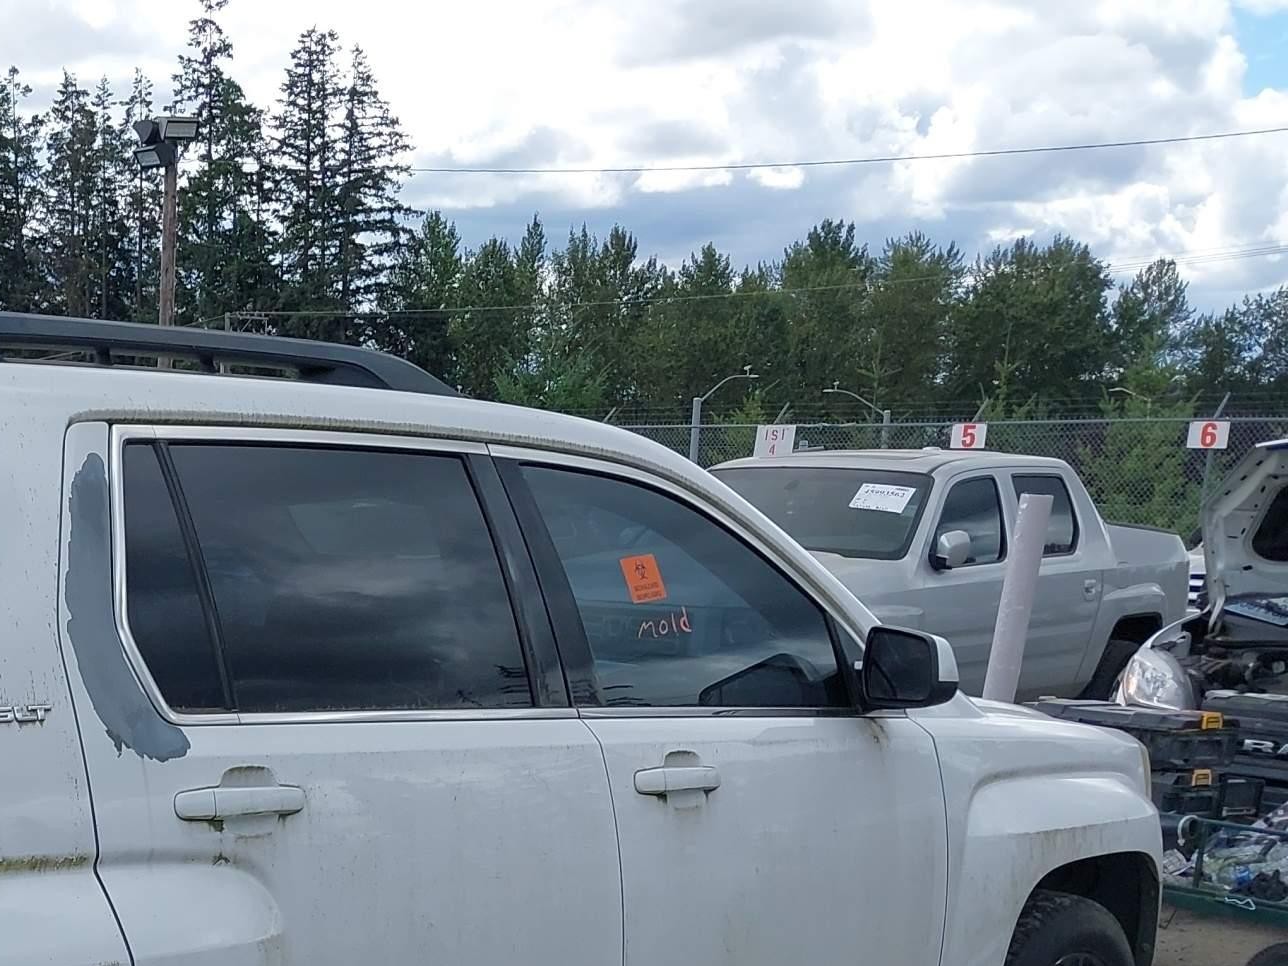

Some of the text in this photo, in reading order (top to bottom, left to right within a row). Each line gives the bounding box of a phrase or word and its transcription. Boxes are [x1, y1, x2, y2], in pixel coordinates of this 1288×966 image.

[961, 425, 976, 448] 5
[1201, 422, 1217, 447] 6
[768, 444, 776, 456] 4
